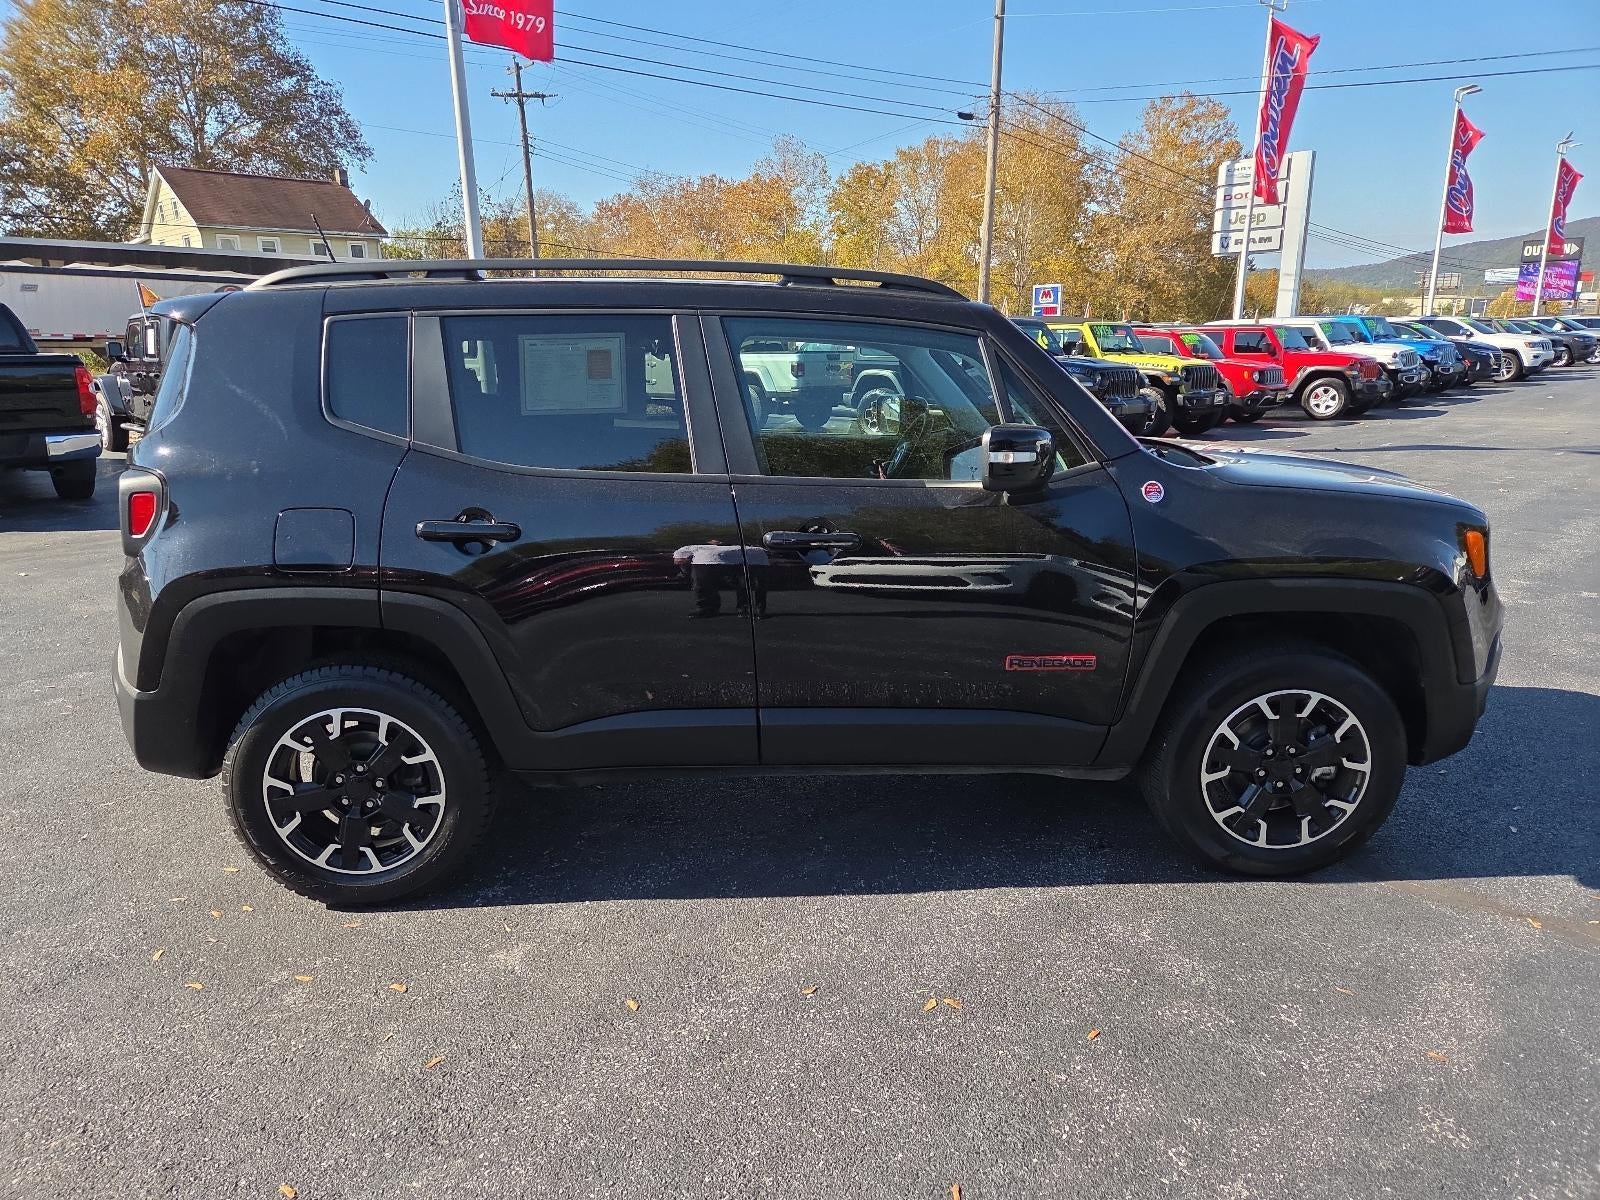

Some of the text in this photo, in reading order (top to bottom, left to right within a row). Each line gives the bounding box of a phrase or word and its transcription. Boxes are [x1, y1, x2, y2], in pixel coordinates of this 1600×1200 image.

[465, 0, 546, 34] Since 1979
[1229, 211, 1267, 226] Jeep
[1233, 235, 1273, 246] RAM
[1005, 655, 1097, 671] RENEGADE
